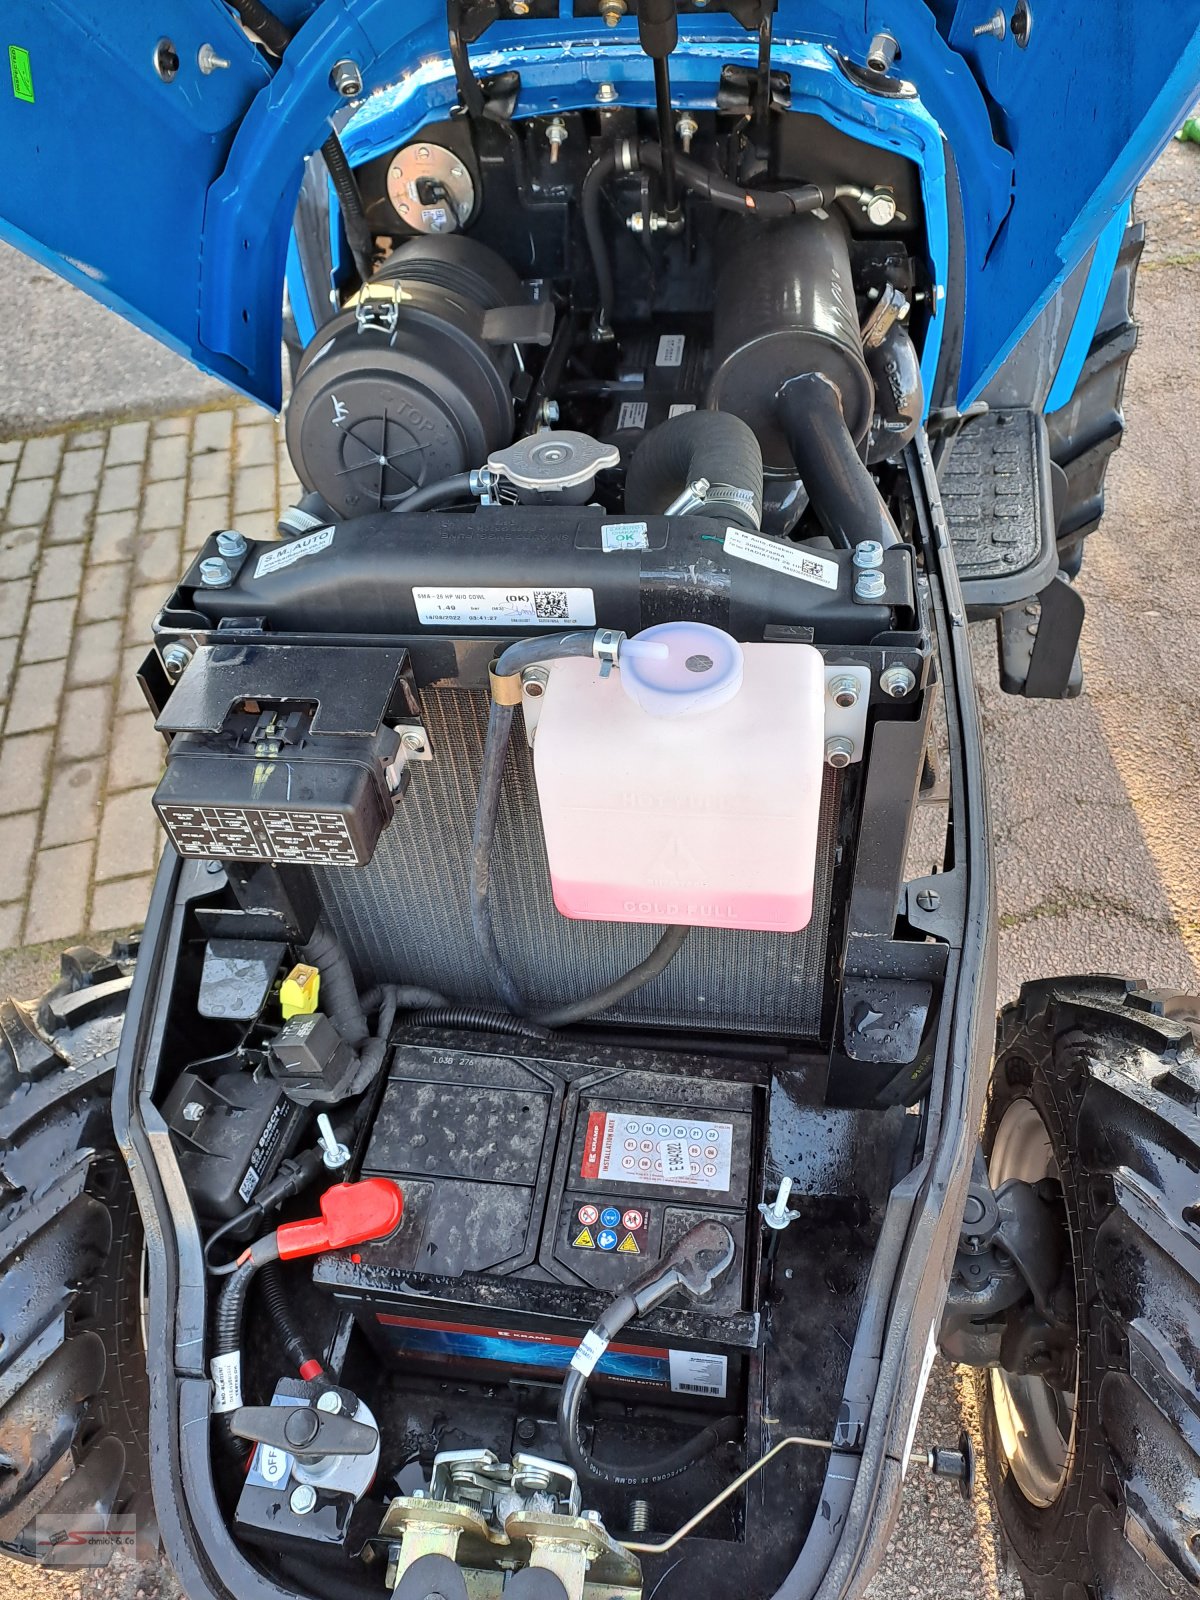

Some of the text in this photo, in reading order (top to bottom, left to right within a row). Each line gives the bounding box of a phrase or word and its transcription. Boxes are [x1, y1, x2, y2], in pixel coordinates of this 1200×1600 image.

[397, 402, 434, 432] TOP
[293, 532, 329, 550] AUTO
[744, 548, 780, 562] RADIATOR
[623, 901, 738, 918] COLD FULL
[259, 1105, 280, 1148] BOSCH
[603, 1134, 613, 1172] INSTALLATION
[268, 1450, 278, 1475] OFF
